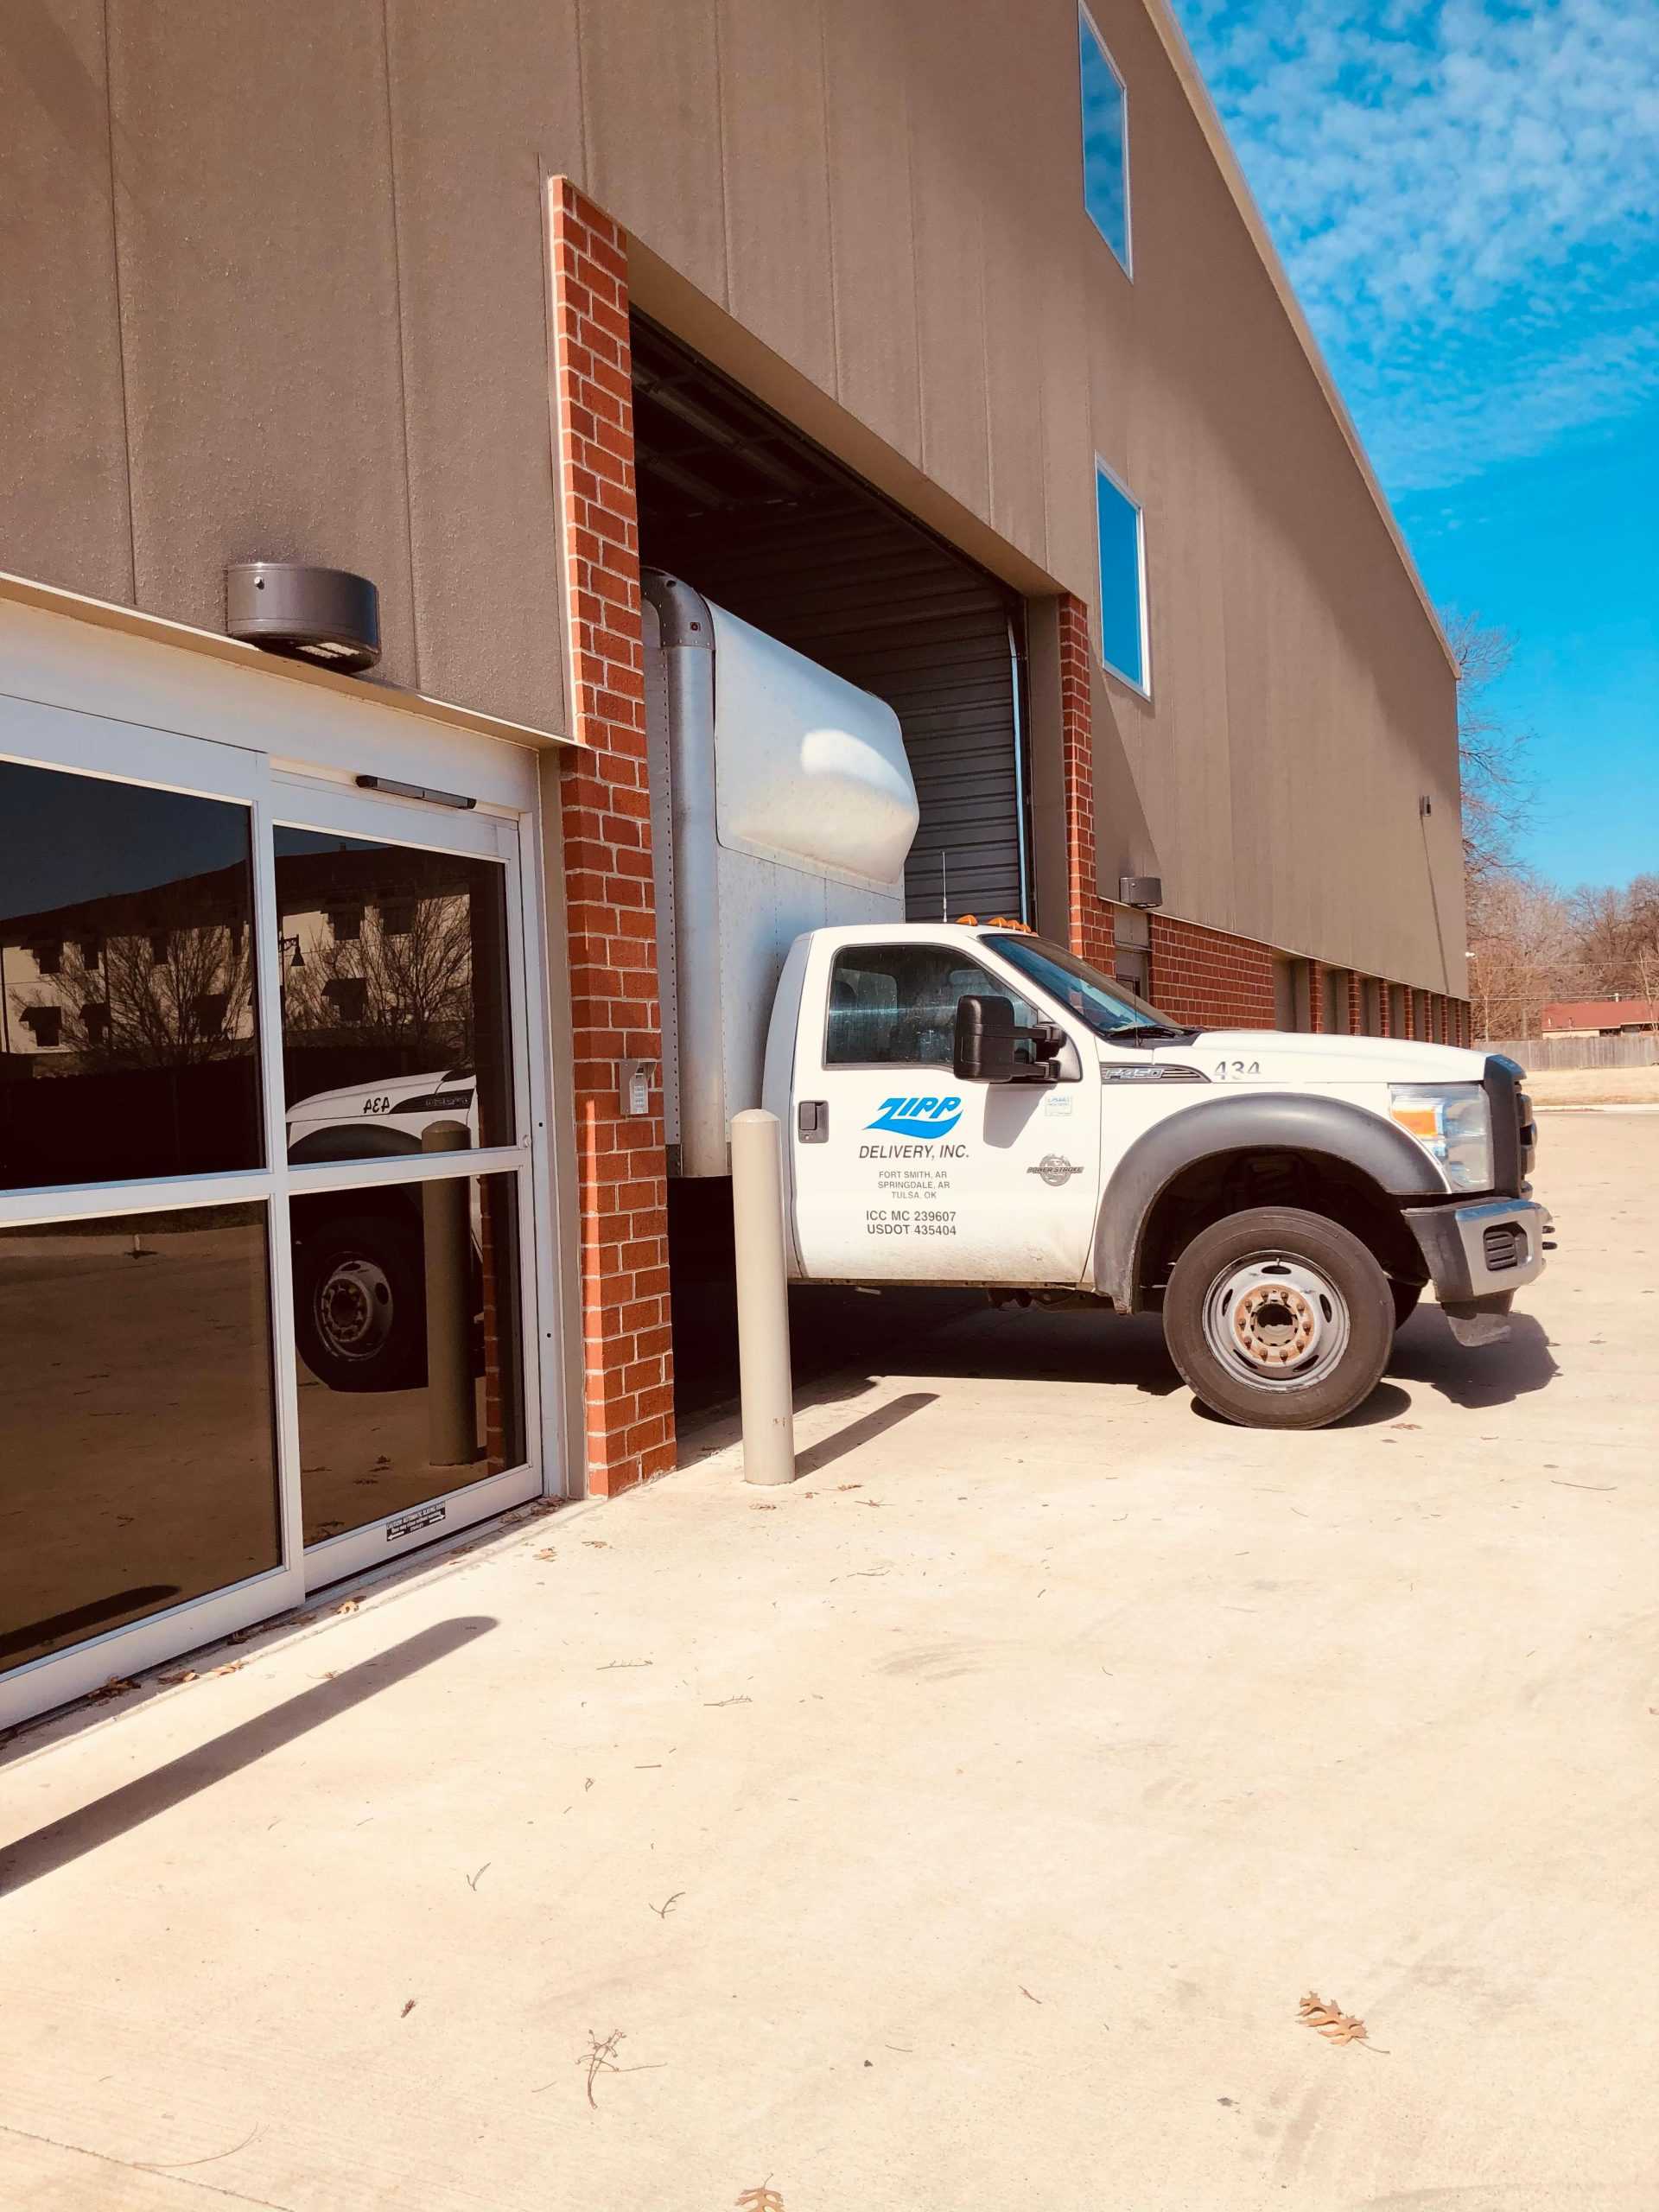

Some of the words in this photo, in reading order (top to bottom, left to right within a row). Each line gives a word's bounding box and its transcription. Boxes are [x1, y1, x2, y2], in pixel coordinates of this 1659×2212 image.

[1214, 1060, 1262, 1080] 434
[862, 1096, 963, 1135] ZIPP
[859, 1144, 936, 1160] DELIVERY,
[939, 1144, 969, 1159] INC.
[904, 1171, 933, 1179] SMITH,
[878, 1181, 935, 1190] SPRINGDALE,
[866, 1210, 889, 1222] ICC
[891, 1210, 910, 1222] MC
[914, 1211, 957, 1222] 239607
[867, 1224, 911, 1236] USDOT
[914, 1224, 957, 1236] 435404
